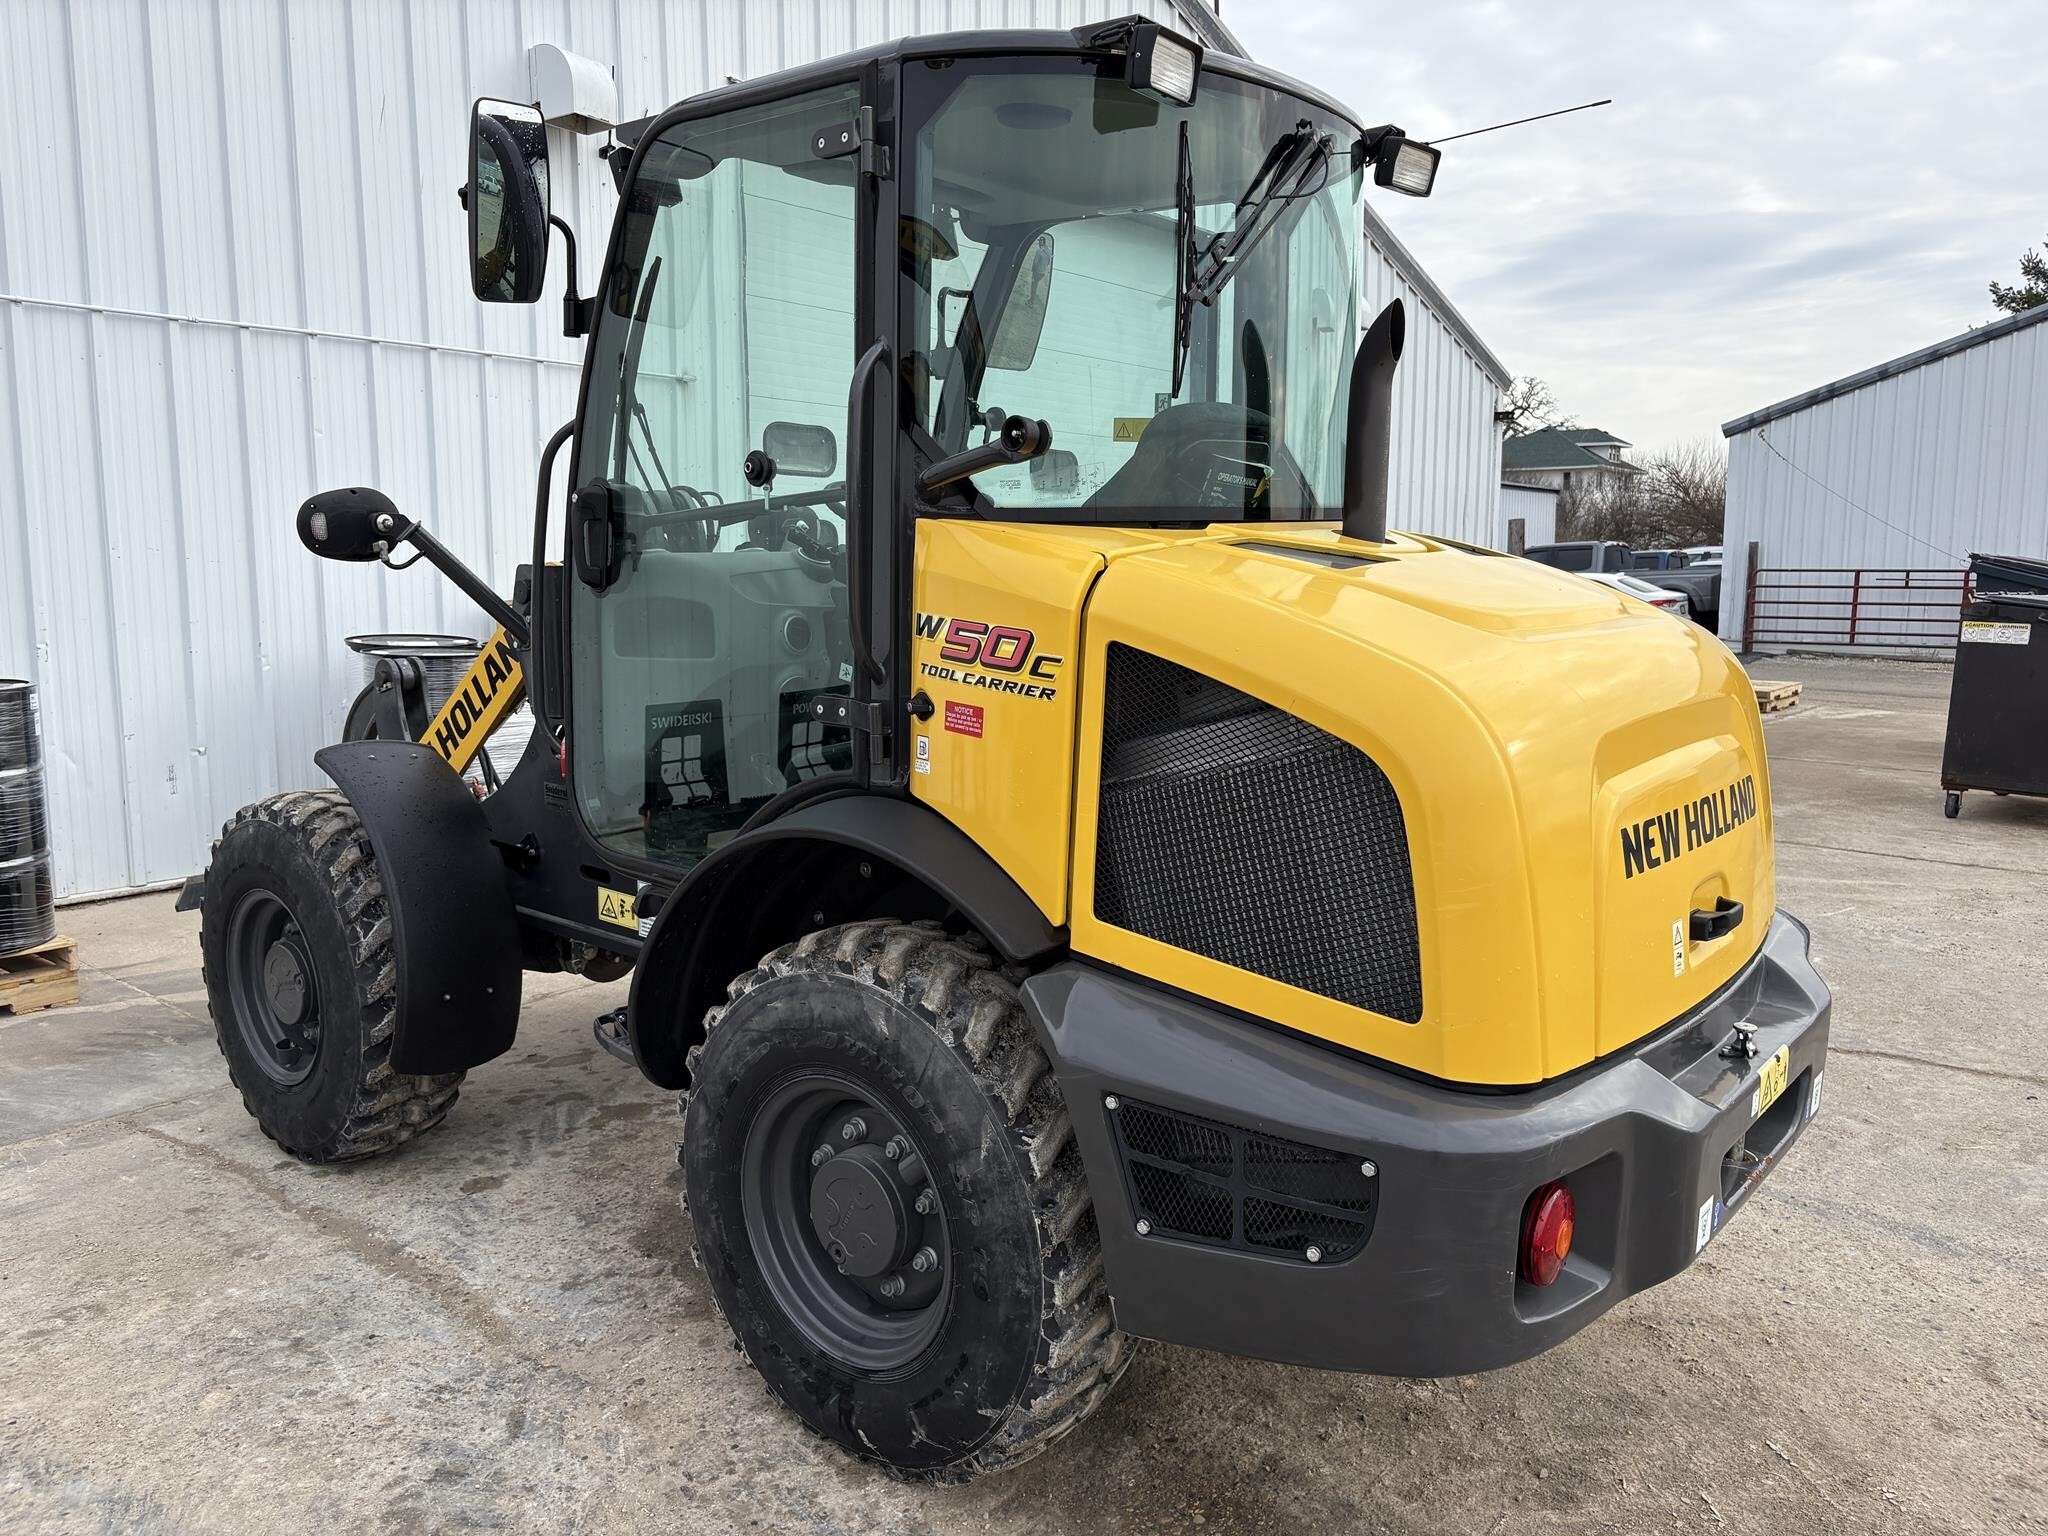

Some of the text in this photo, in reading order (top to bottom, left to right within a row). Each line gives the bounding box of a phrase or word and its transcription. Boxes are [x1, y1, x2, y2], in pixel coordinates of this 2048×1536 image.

[435, 630, 520, 761] HOLLAN
[921, 662, 1057, 701] TOOL CARRIER
[651, 712, 712, 729] SWIDERSKI
[954, 706, 974, 716] NOTICE
[1620, 774, 1756, 880] NEW HOLLAND
